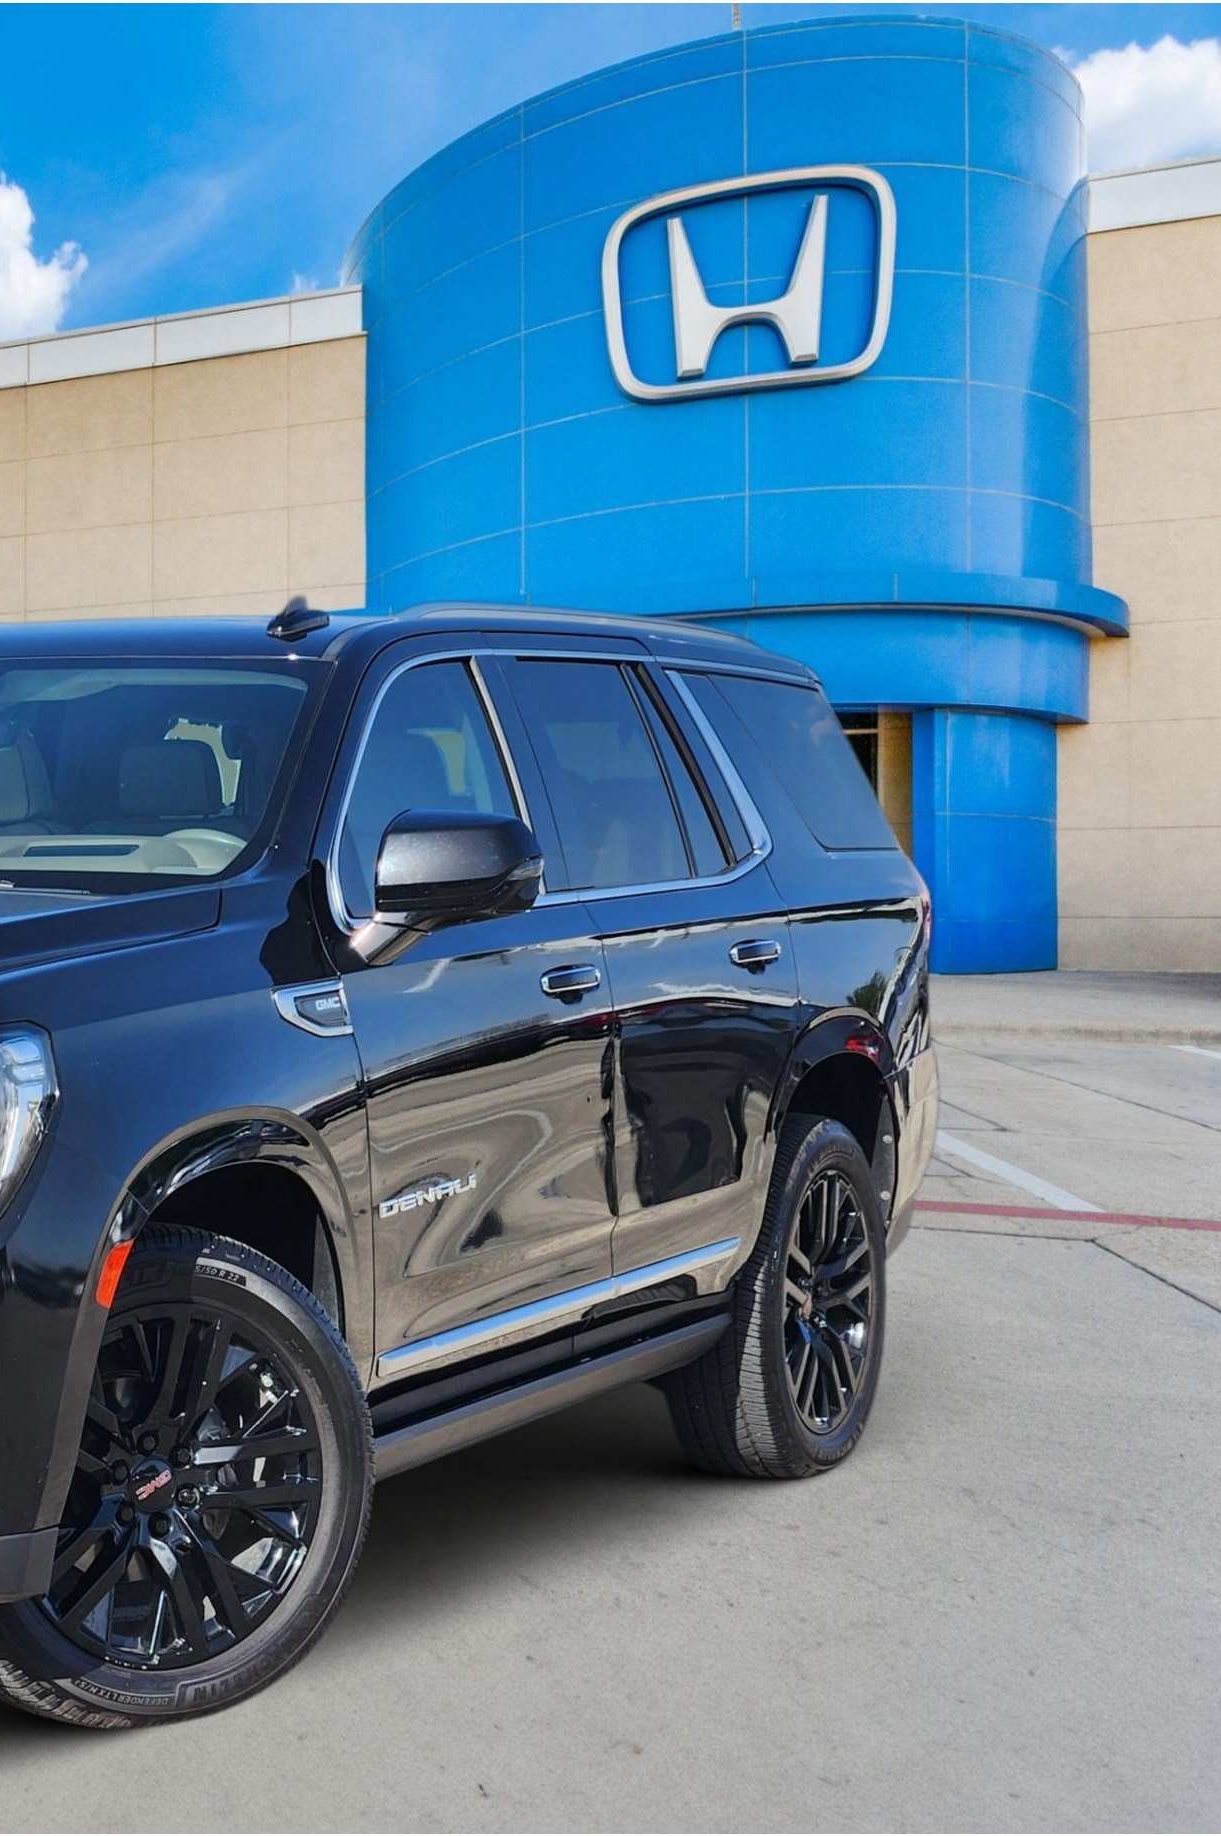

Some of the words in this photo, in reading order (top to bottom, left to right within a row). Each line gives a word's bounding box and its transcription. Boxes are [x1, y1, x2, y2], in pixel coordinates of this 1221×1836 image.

[315, 996, 340, 1011] GMC
[379, 1172, 477, 1218] DENALI
[135, 1470, 172, 1500] GMC
[118, 1694, 169, 1705] DEFENDER
